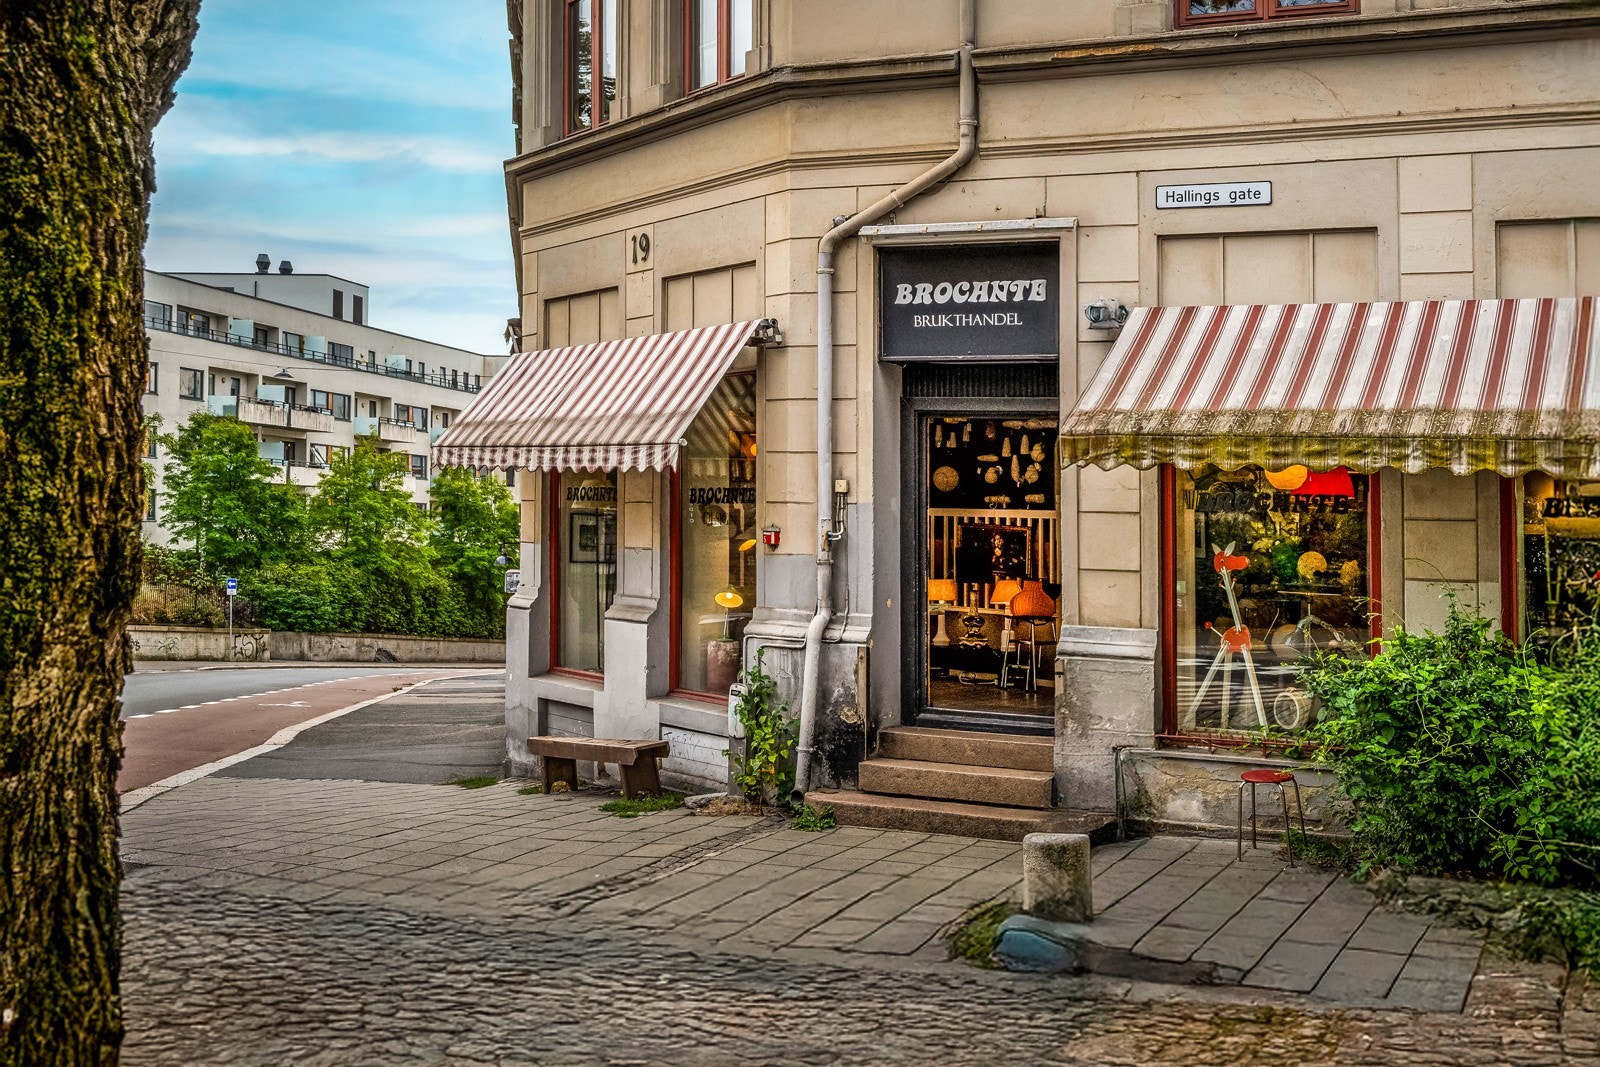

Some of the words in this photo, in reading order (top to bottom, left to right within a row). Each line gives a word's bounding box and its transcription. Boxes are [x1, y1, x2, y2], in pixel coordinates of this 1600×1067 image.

[1165, 190, 1220, 204] Hallings
[1229, 188, 1261, 203] gate
[631, 233, 650, 265] 19
[894, 279, 1047, 305] BROCANTE
[914, 313, 1023, 327] BRUKTHANDEL
